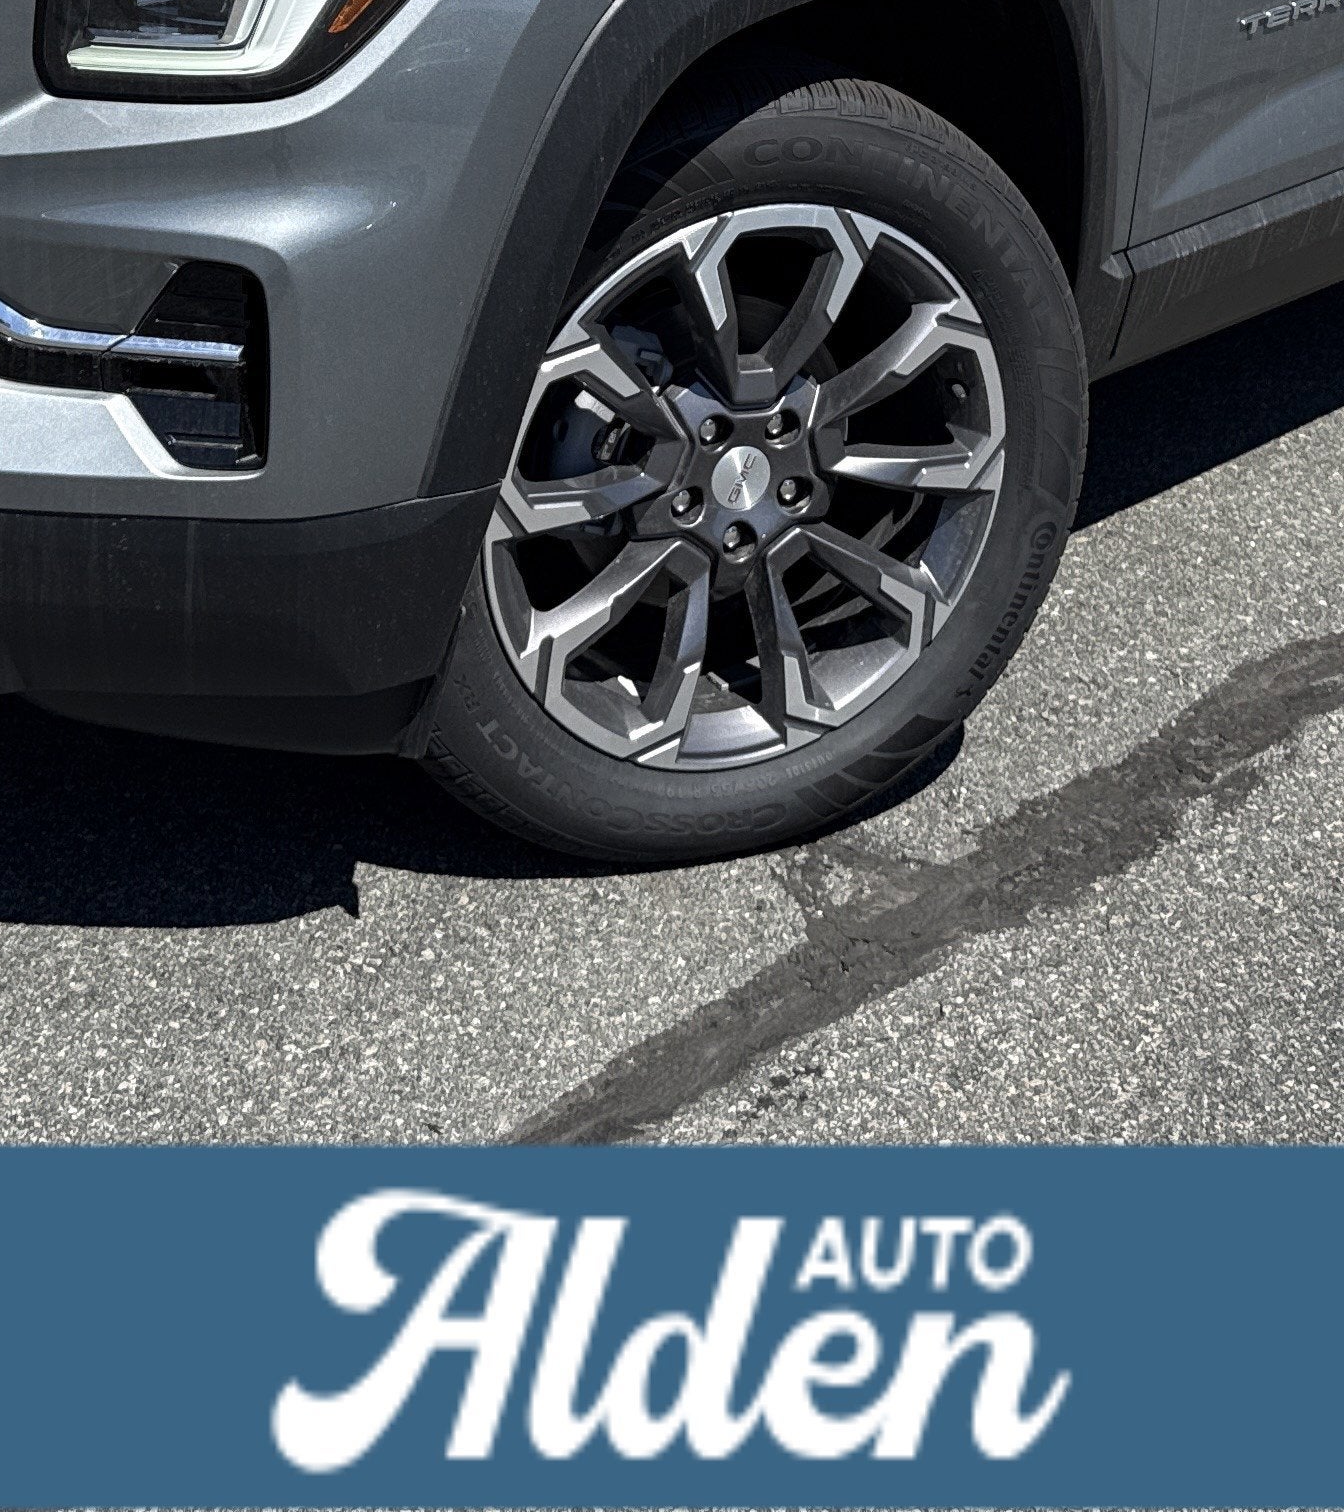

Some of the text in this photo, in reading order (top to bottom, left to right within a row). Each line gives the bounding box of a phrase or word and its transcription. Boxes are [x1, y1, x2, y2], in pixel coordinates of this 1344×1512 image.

[742, 136, 1054, 338] CONTINENTAL
[727, 453, 758, 504] GMC
[968, 521, 1057, 681] Continental
